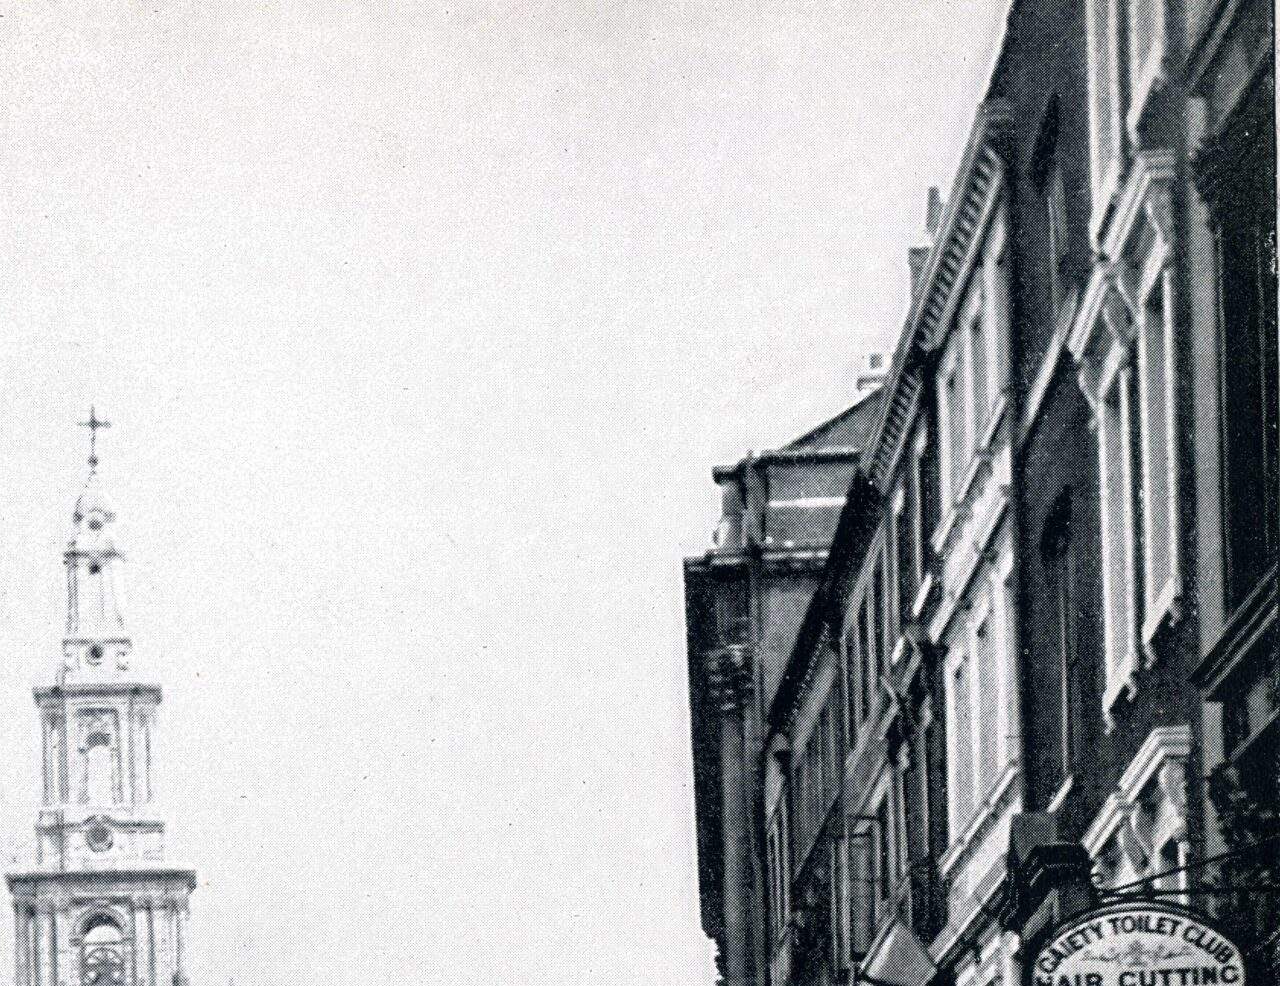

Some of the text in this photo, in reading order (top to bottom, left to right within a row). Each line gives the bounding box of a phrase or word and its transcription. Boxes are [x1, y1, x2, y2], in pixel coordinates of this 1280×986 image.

[1040, 915, 1235, 973] GAIETY TOILET CLUB
